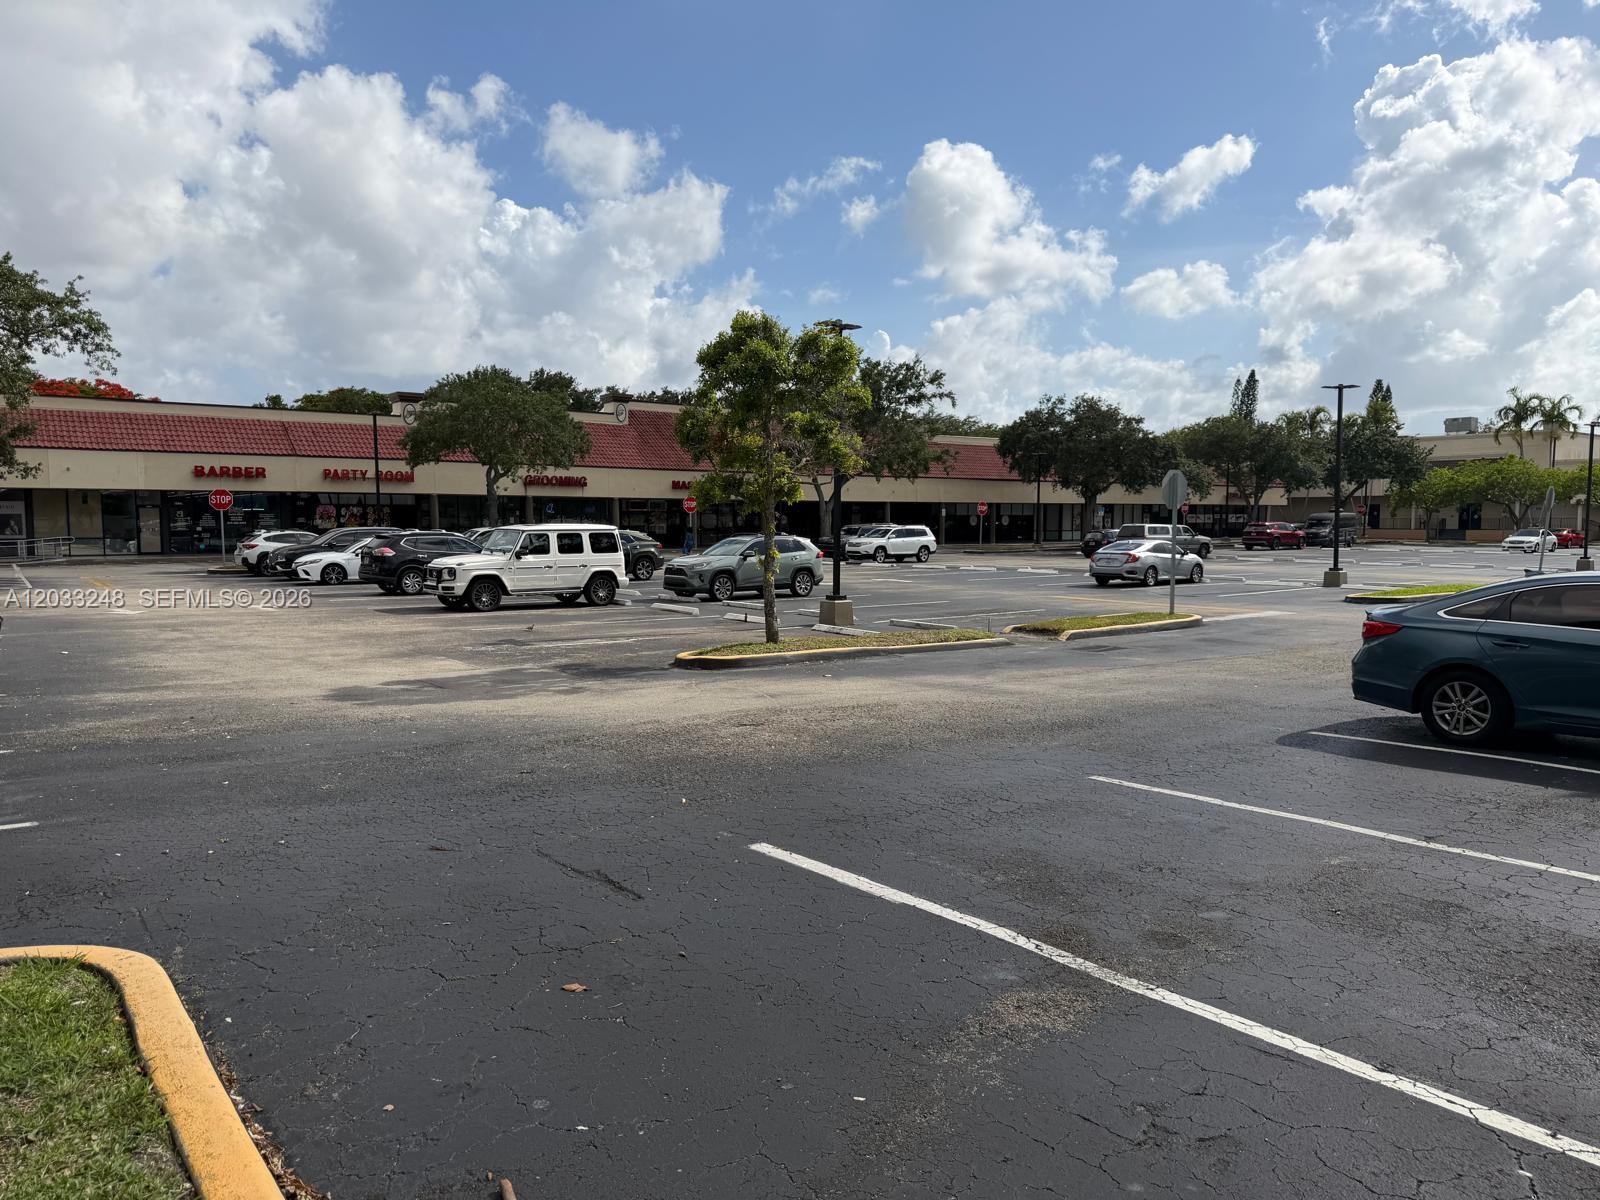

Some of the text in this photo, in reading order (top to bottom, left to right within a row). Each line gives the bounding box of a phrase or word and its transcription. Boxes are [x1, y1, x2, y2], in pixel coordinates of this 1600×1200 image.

[193, 465, 267, 479] BARBER
[322, 468, 415, 483] PARTY ROOM
[524, 474, 588, 487] GROOMING
[210, 495, 231, 504] STOP
